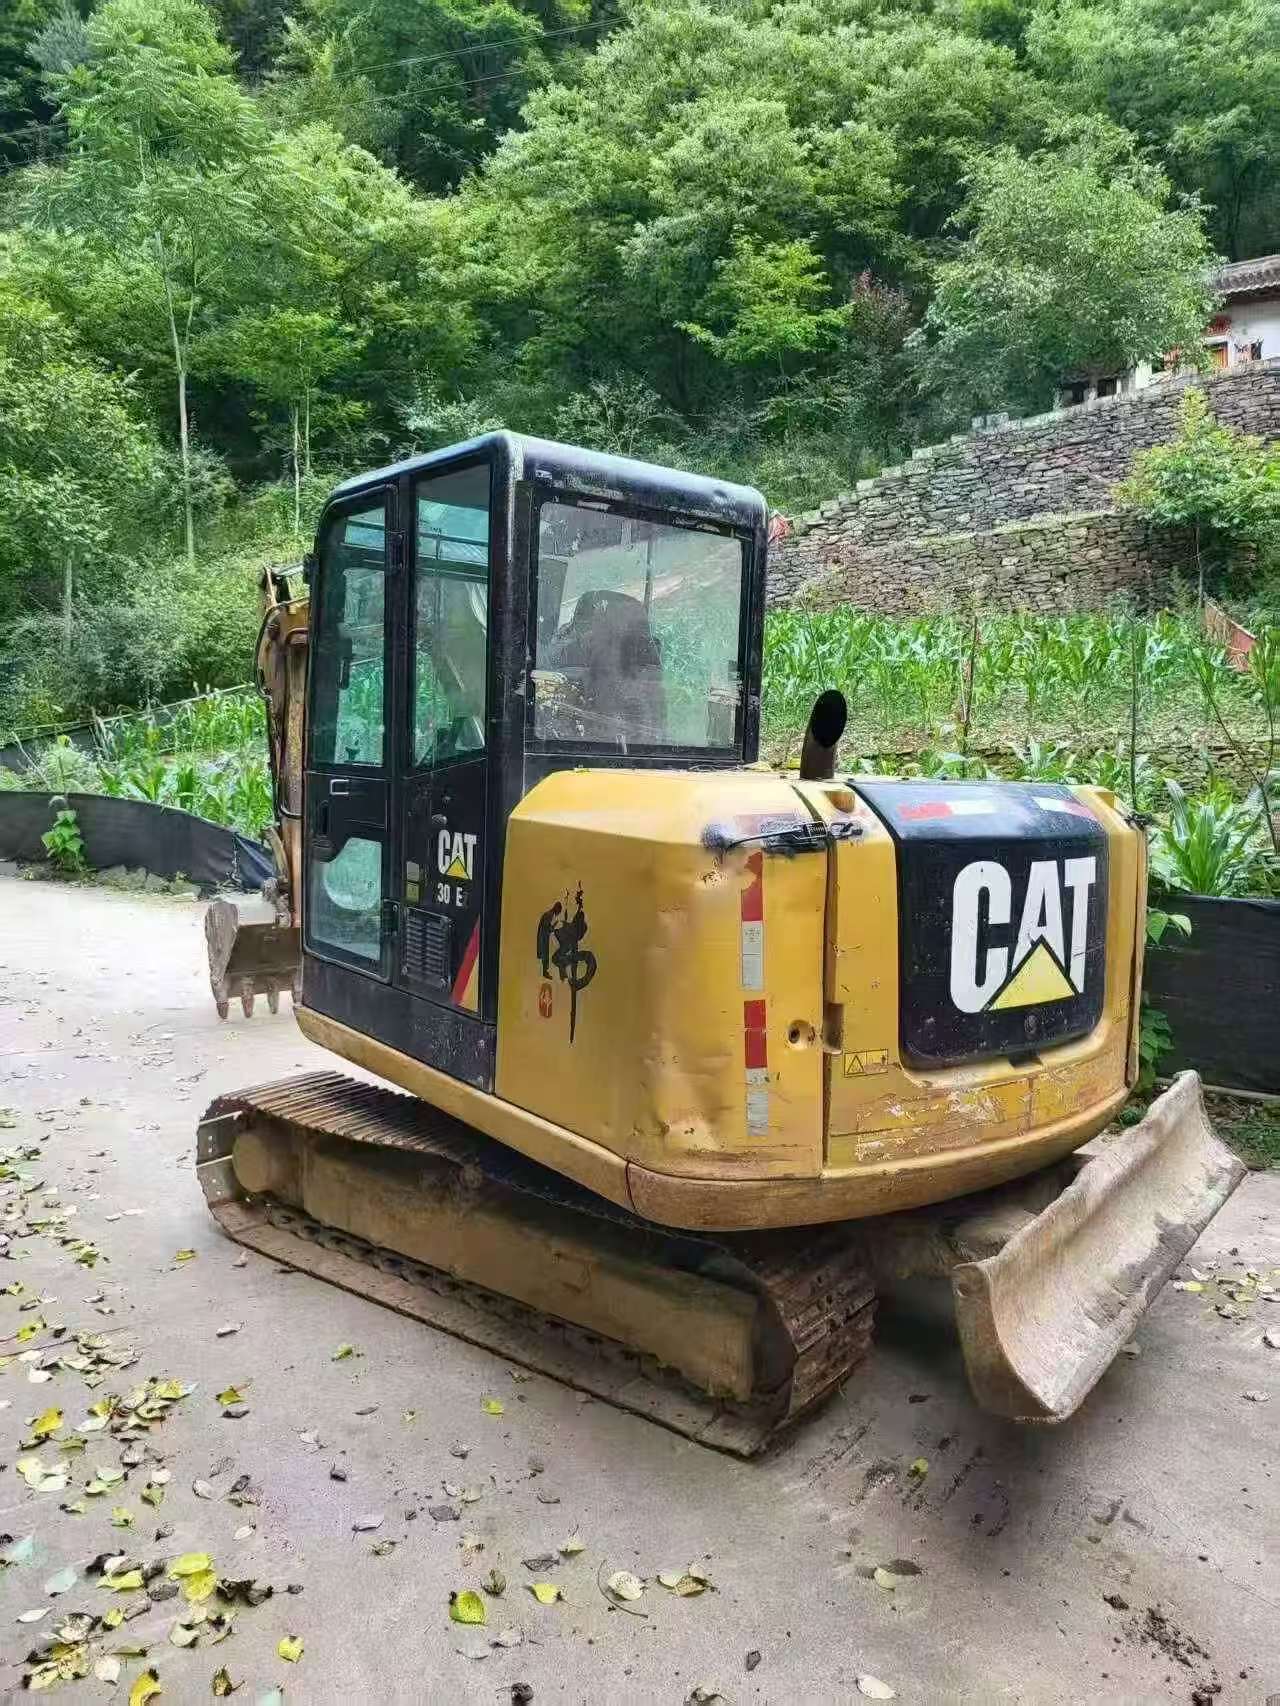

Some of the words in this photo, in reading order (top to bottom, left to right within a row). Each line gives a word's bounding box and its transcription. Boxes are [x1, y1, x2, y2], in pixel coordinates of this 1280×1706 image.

[437, 829, 477, 880] CAT
[437, 882, 451, 905] 30
[456, 886, 464, 907] E
[950, 856, 1096, 1014] CAT
